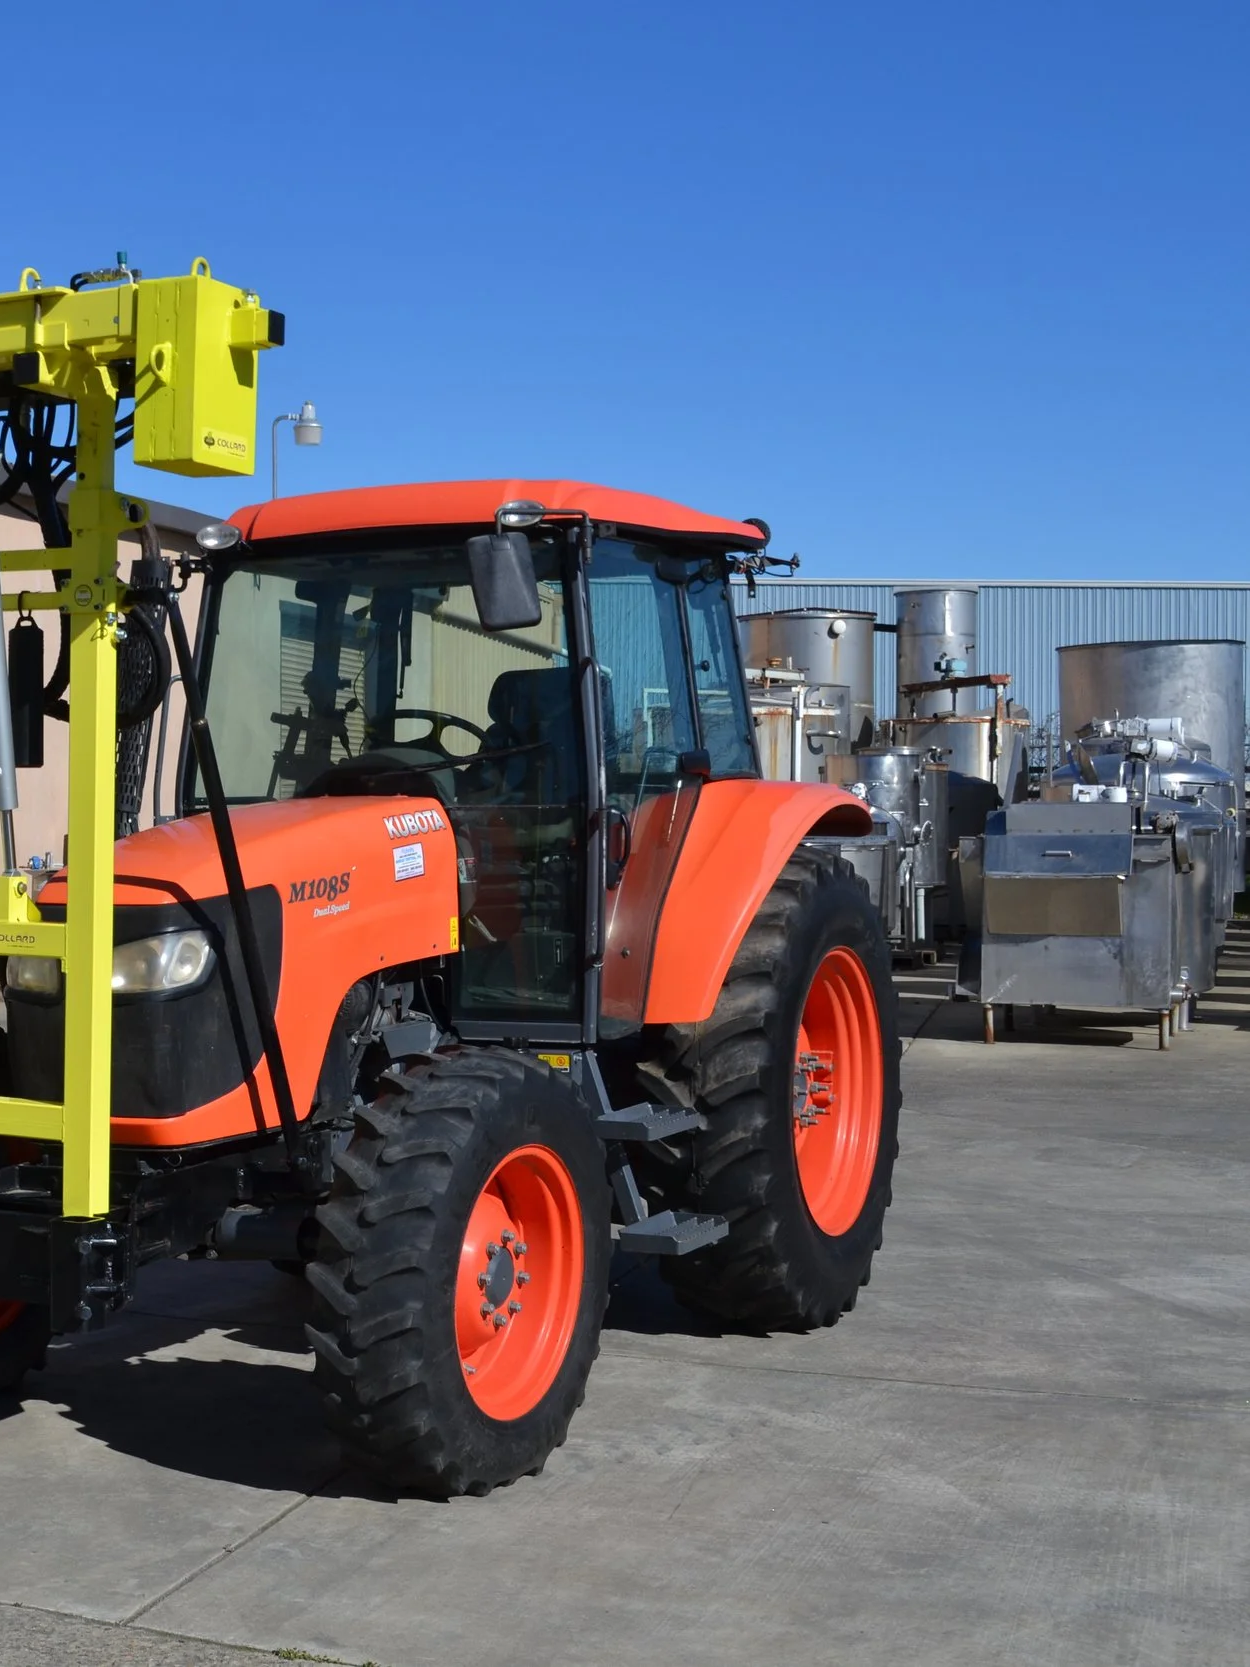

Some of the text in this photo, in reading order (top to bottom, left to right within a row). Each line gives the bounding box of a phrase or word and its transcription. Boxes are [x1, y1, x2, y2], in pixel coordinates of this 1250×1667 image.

[216, 438, 246, 453] COLLARD
[382, 809, 446, 840] KUBOTA
[288, 872, 351, 904] M108S
